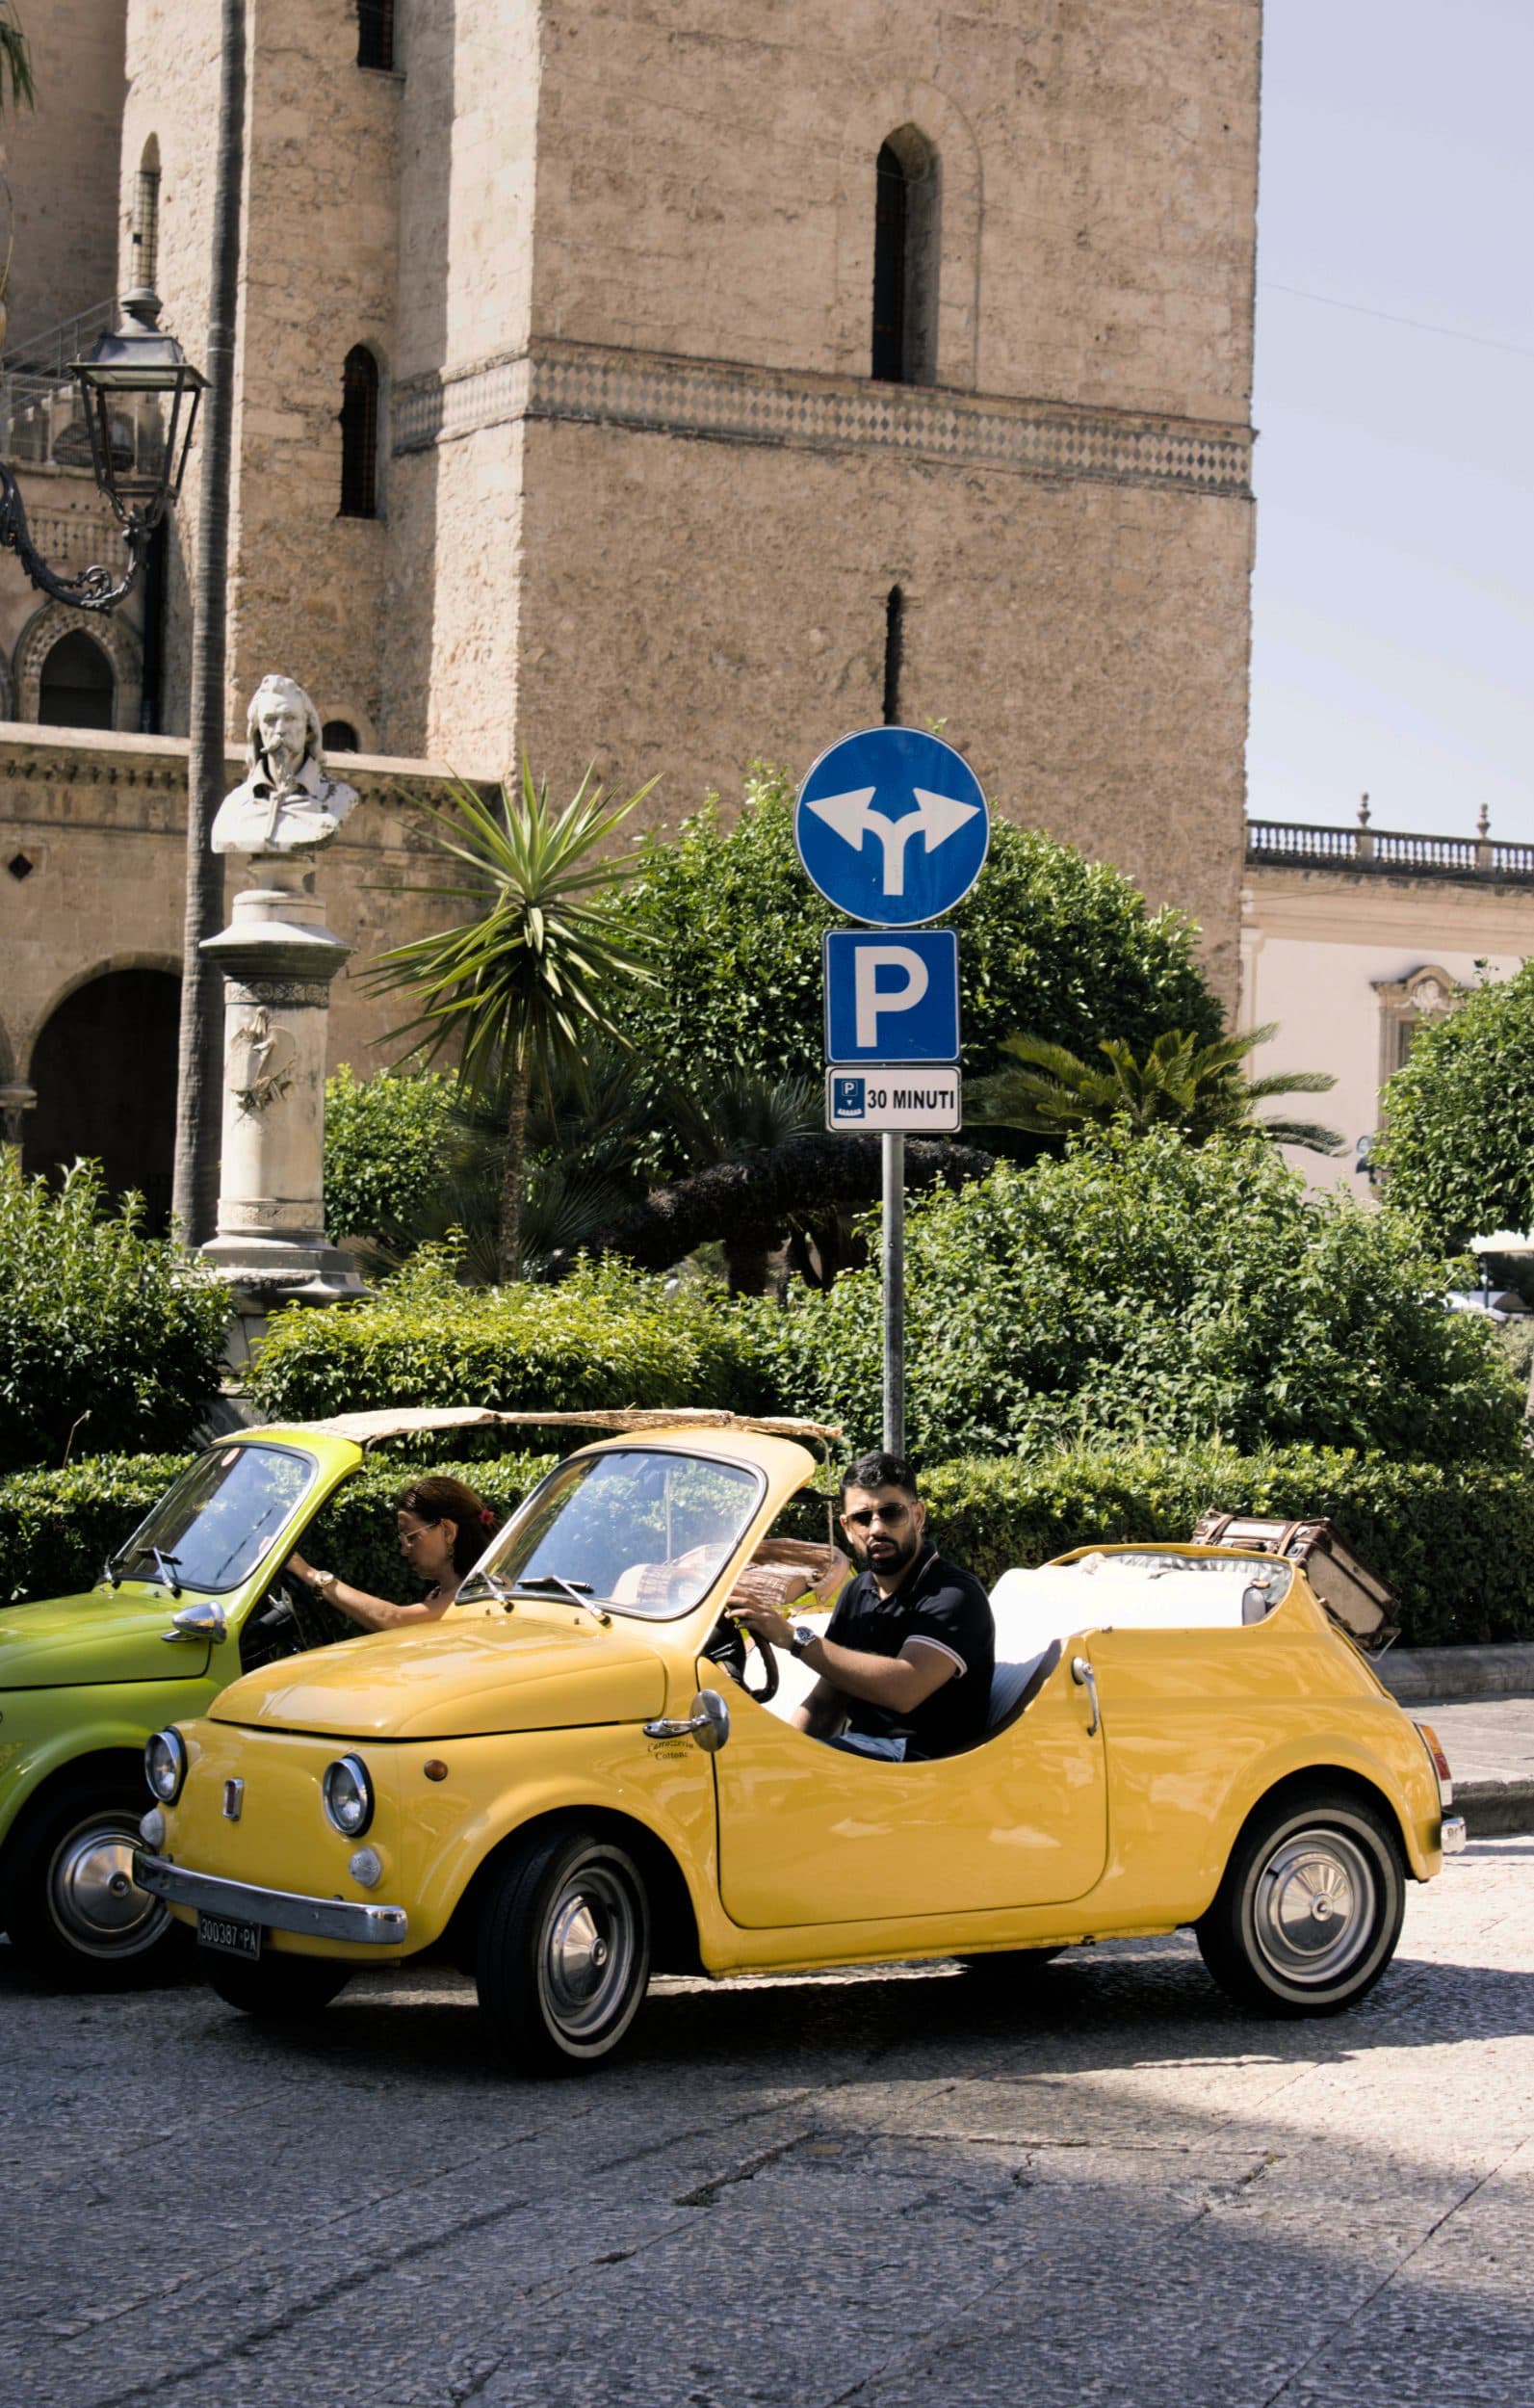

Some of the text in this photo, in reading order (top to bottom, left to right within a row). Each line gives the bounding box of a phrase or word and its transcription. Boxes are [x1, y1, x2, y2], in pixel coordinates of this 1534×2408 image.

[854, 945, 929, 1048] P
[845, 1082, 855, 1095] P
[868, 1089, 954, 1110] 30 MINUTI
[201, 1918, 256, 1950] 300387 PA
